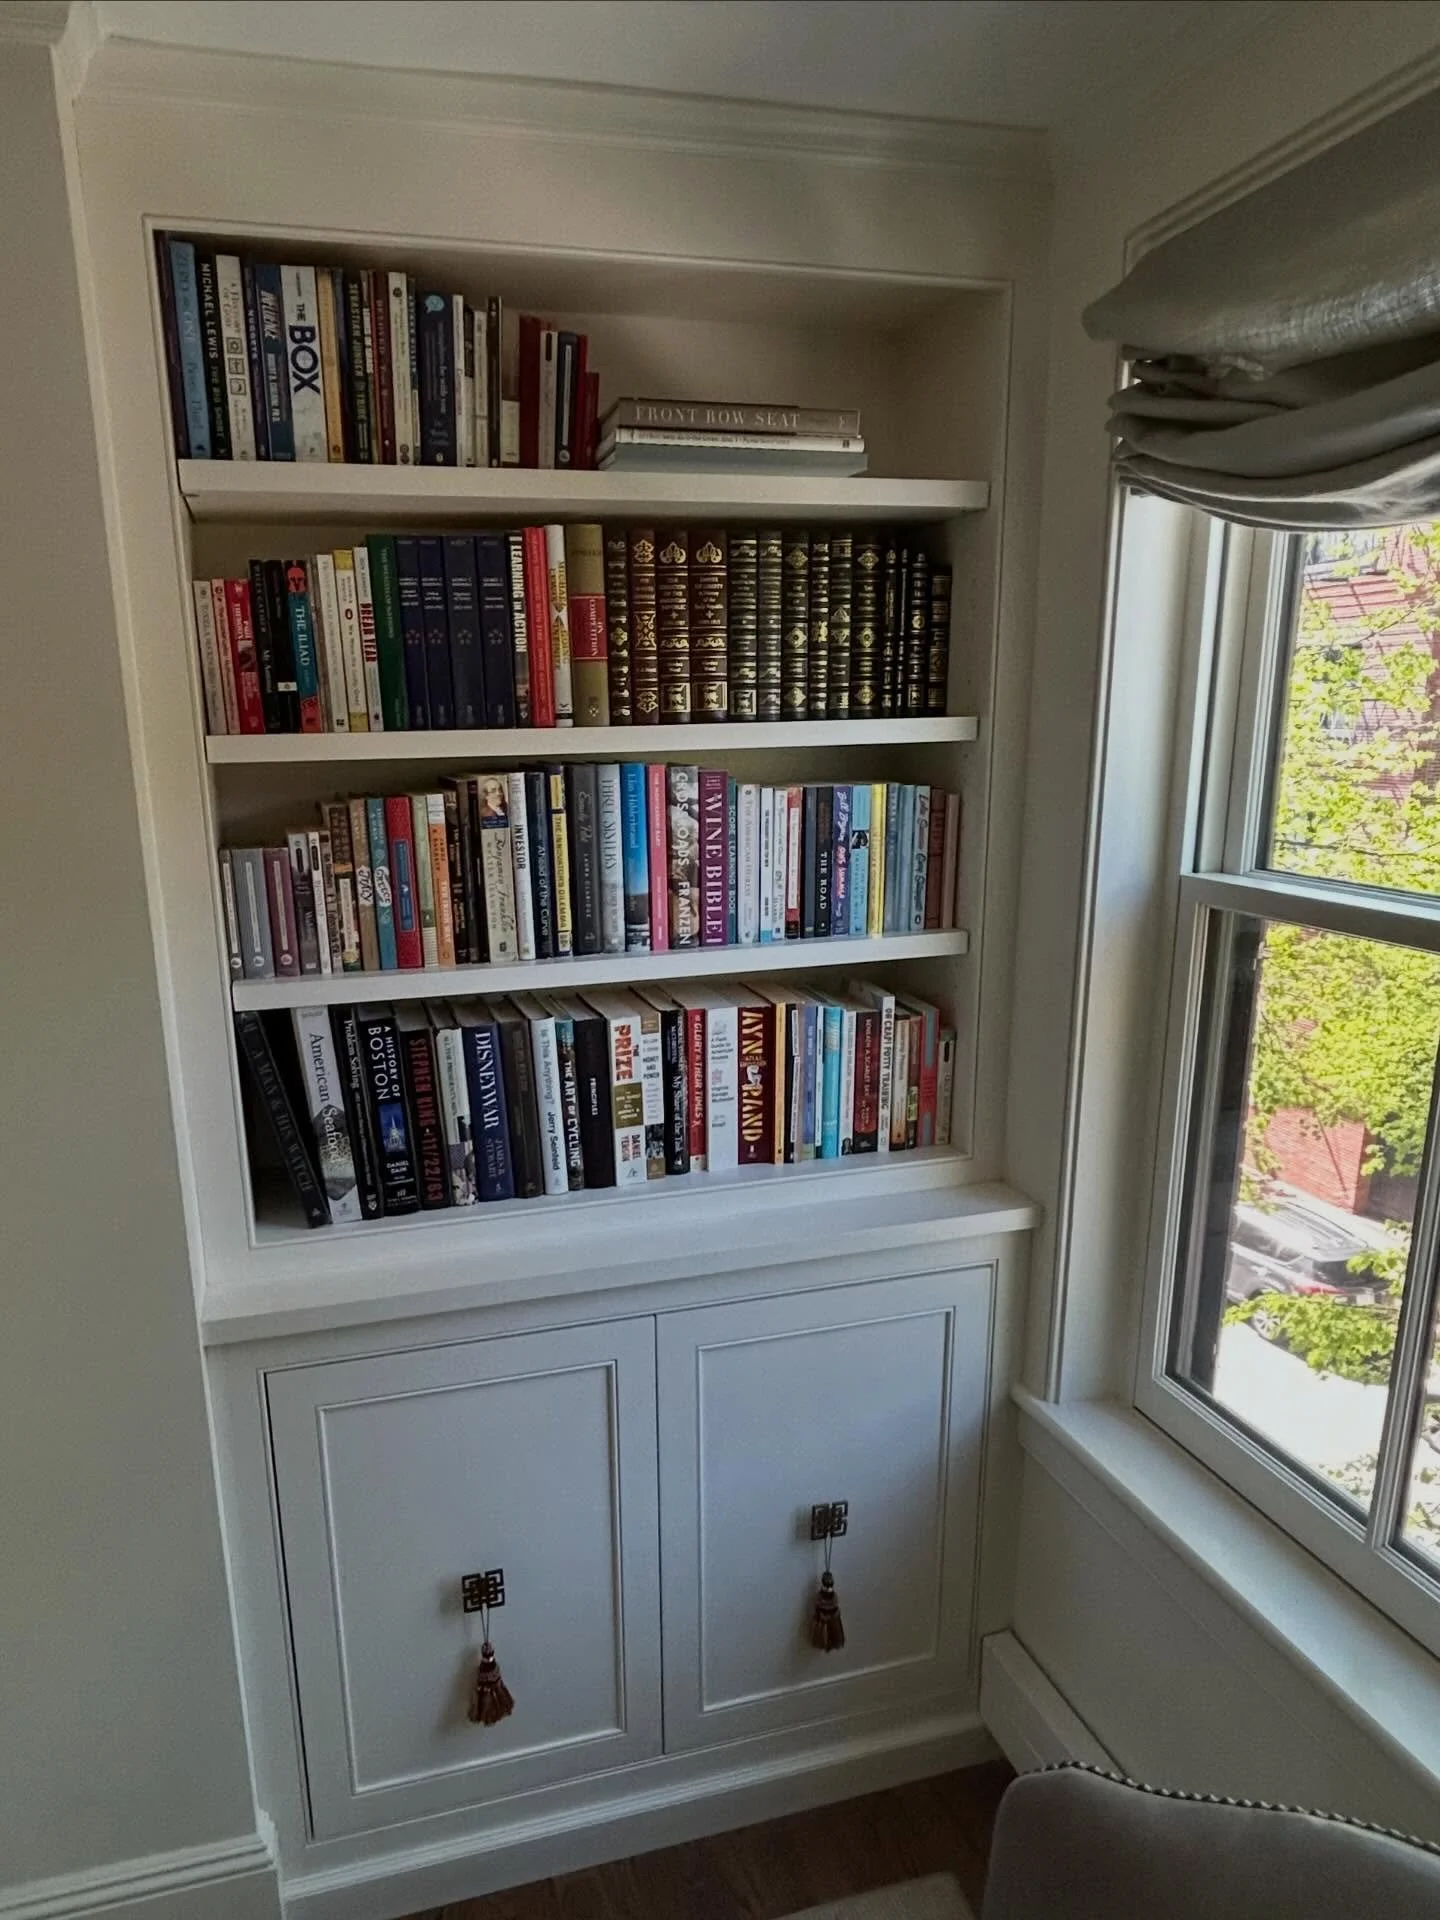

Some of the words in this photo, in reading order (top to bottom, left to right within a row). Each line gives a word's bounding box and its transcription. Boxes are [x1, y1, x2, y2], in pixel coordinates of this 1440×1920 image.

[200, 263, 214, 314] MICHAEL
[207, 321, 218, 359] LEWIS
[296, 304, 306, 321] THE
[349, 283, 362, 337] SEBASTIAN
[248, 310, 258, 360] NUGGETS
[288, 325, 320, 395] BOX
[214, 407, 224, 438] SHORT
[635, 406, 698, 424] FRONT
[706, 408, 745, 425] ROW
[754, 411, 799, 429] SEAT
[382, 565, 390, 593] WEALTH
[510, 545, 524, 598] LEARNING
[385, 594, 391, 604] OF
[295, 606, 305, 631] THE
[386, 605, 394, 639] NATIONS
[513, 612, 527, 652] ACTION
[589, 599, 598, 656] COMPETITION
[597, 621, 604, 634] ON
[297, 634, 310, 666] ILIAD
[602, 780, 615, 815] THREE
[837, 792, 849, 810] Bill
[555, 816, 563, 832] THE
[629, 794, 640, 848] Hilderbrand
[705, 793, 723, 859] WINE
[492, 832, 506, 884] Benjamin
[514, 825, 526, 869] INVESTOR
[537, 846, 545, 876] Ahead
[603, 820, 616, 870] SISTERS
[376, 868, 391, 904] GREECE
[539, 879, 546, 888] of
[540, 890, 548, 907] the
[706, 865, 723, 933] BIBLE
[541, 909, 549, 936] Curve
[558, 890, 567, 928] DILEMMA
[678, 882, 691, 945] FRANZEN
[343, 1019, 356, 1055] Problem
[541, 1029, 548, 1038] Is
[542, 1040, 550, 1058] This
[694, 1023, 702, 1053] GLORY
[742, 1011, 763, 1056] AYN
[252, 1048, 263, 1059] A
[367, 1026, 390, 1100] BOSTON
[385, 1036, 398, 1079] HISTORY
[392, 1084, 401, 1097] OF
[409, 1038, 433, 1093] STEPHEN
[564, 1060, 573, 1078] THE
[614, 1025, 633, 1081] PRIZE
[863, 1055, 872, 1082] SCARLET
[882, 1047, 891, 1069] POTTY
[259, 1063, 277, 1096] MAN
[348, 1056, 360, 1089] Solving
[475, 1031, 500, 1130] DISNEYWAR
[543, 1060, 554, 1104] Anything?
[672, 1075, 682, 1088] My
[694, 1061, 702, 1088] THEIR
[271, 1099, 282, 1112] &
[309, 1033, 331, 1102] American
[322, 1107, 343, 1163] Seafood
[564, 1080, 576, 1103] ART
[589, 1077, 598, 1116] PRINCIPLES
[673, 1090, 682, 1111] Share
[695, 1091, 703, 1118] TIMES
[881, 1073, 890, 1110] TRAINING
[276, 1113, 292, 1138] HIS
[416, 1096, 435, 1126] KING
[548, 1112, 557, 1133] Jerry
[568, 1105, 575, 1115] OF
[741, 1083, 763, 1142] RAND
[567, 1118, 580, 1167] CYCLING
[674, 1122, 683, 1135] the
[486, 1138, 497, 1178] STEWART
[550, 1136, 560, 1170] Seinfeld
[632, 1134, 641, 1159] DANIEL
[287, 1143, 314, 1193] WATCH
